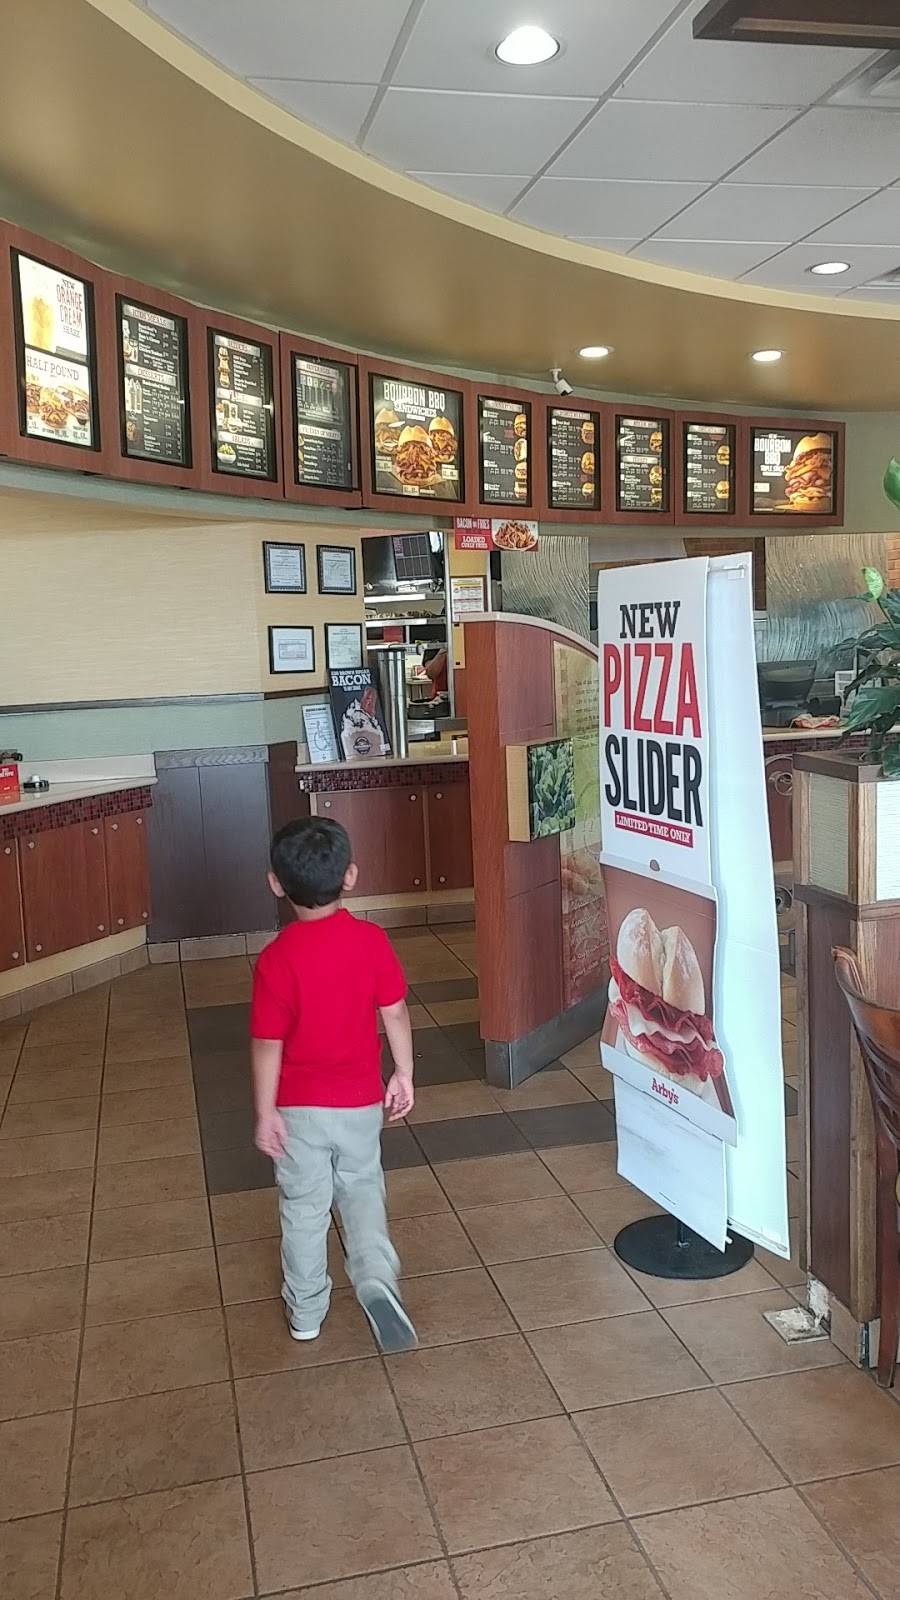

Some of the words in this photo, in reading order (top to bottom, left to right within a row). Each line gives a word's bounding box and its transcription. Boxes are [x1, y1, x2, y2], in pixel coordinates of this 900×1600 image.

[56, 284, 83, 312] ORANGE
[60, 304, 82, 329] CREAM
[26, 355, 49, 371] HALF
[50, 363, 80, 381] POUND
[383, 382, 426, 407] BOURBON
[428, 390, 446, 412] BBQ
[462, 535, 486, 543] LOADED
[619, 600, 681, 639] NEW
[331, 673, 372, 687] BACON
[603, 642, 702, 738] PIZZA
[604, 733, 704, 827] SLIDER
[615, 813, 648, 832] LIMITED
[648, 821, 669, 837] TIME
[669, 826, 691, 844] ONLY
[651, 1077, 680, 1105] Arby's
